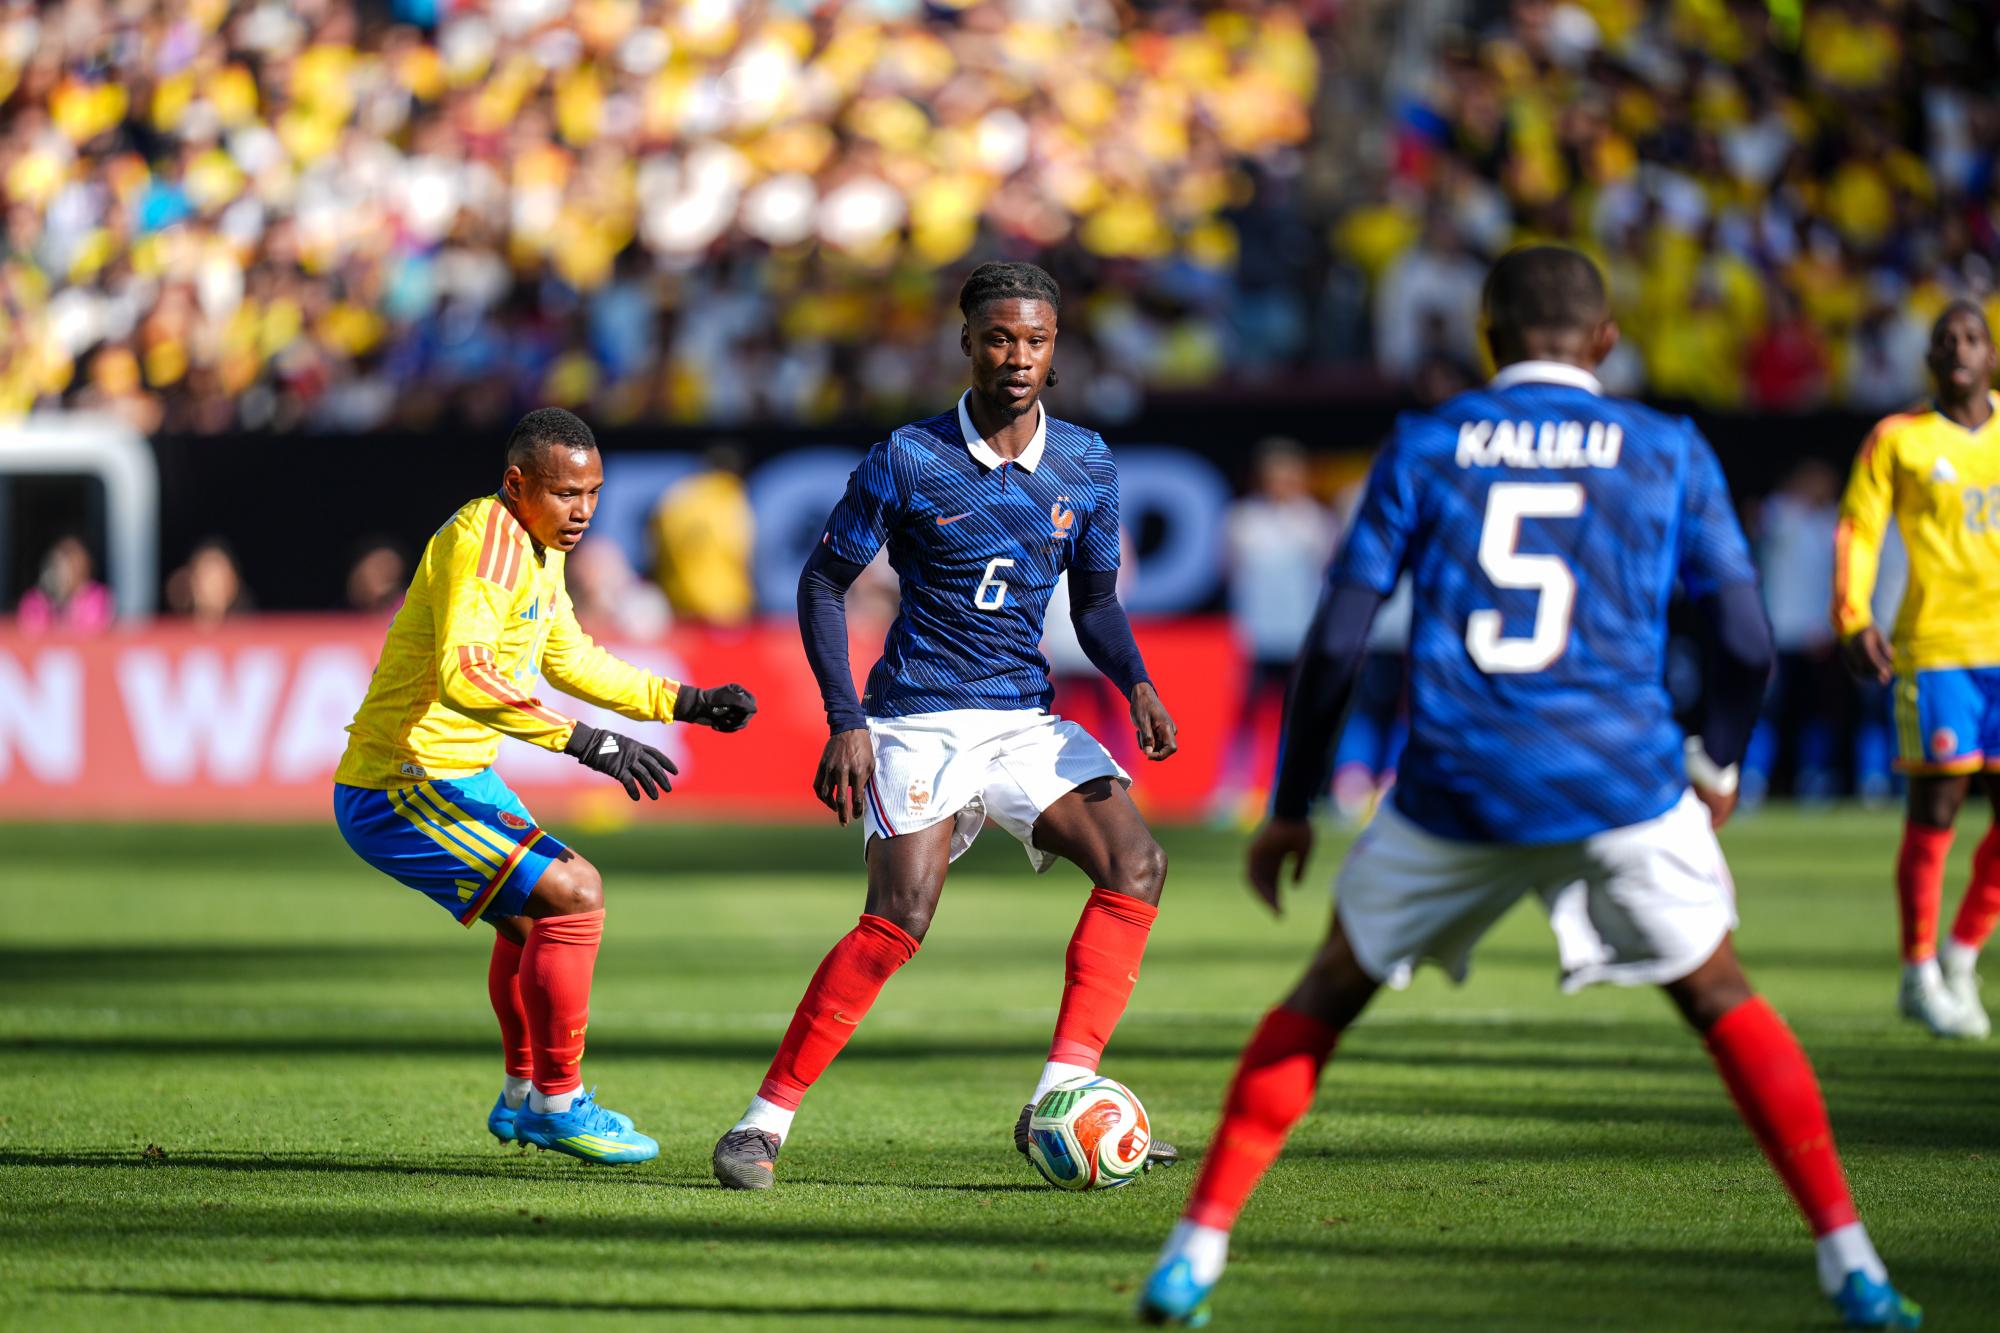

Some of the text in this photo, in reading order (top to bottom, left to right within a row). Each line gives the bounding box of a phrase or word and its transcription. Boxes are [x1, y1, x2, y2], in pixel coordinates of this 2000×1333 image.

[1455, 420, 1623, 469] KALULU
[974, 558, 1015, 610] 6
[1466, 481, 1584, 674] 5
